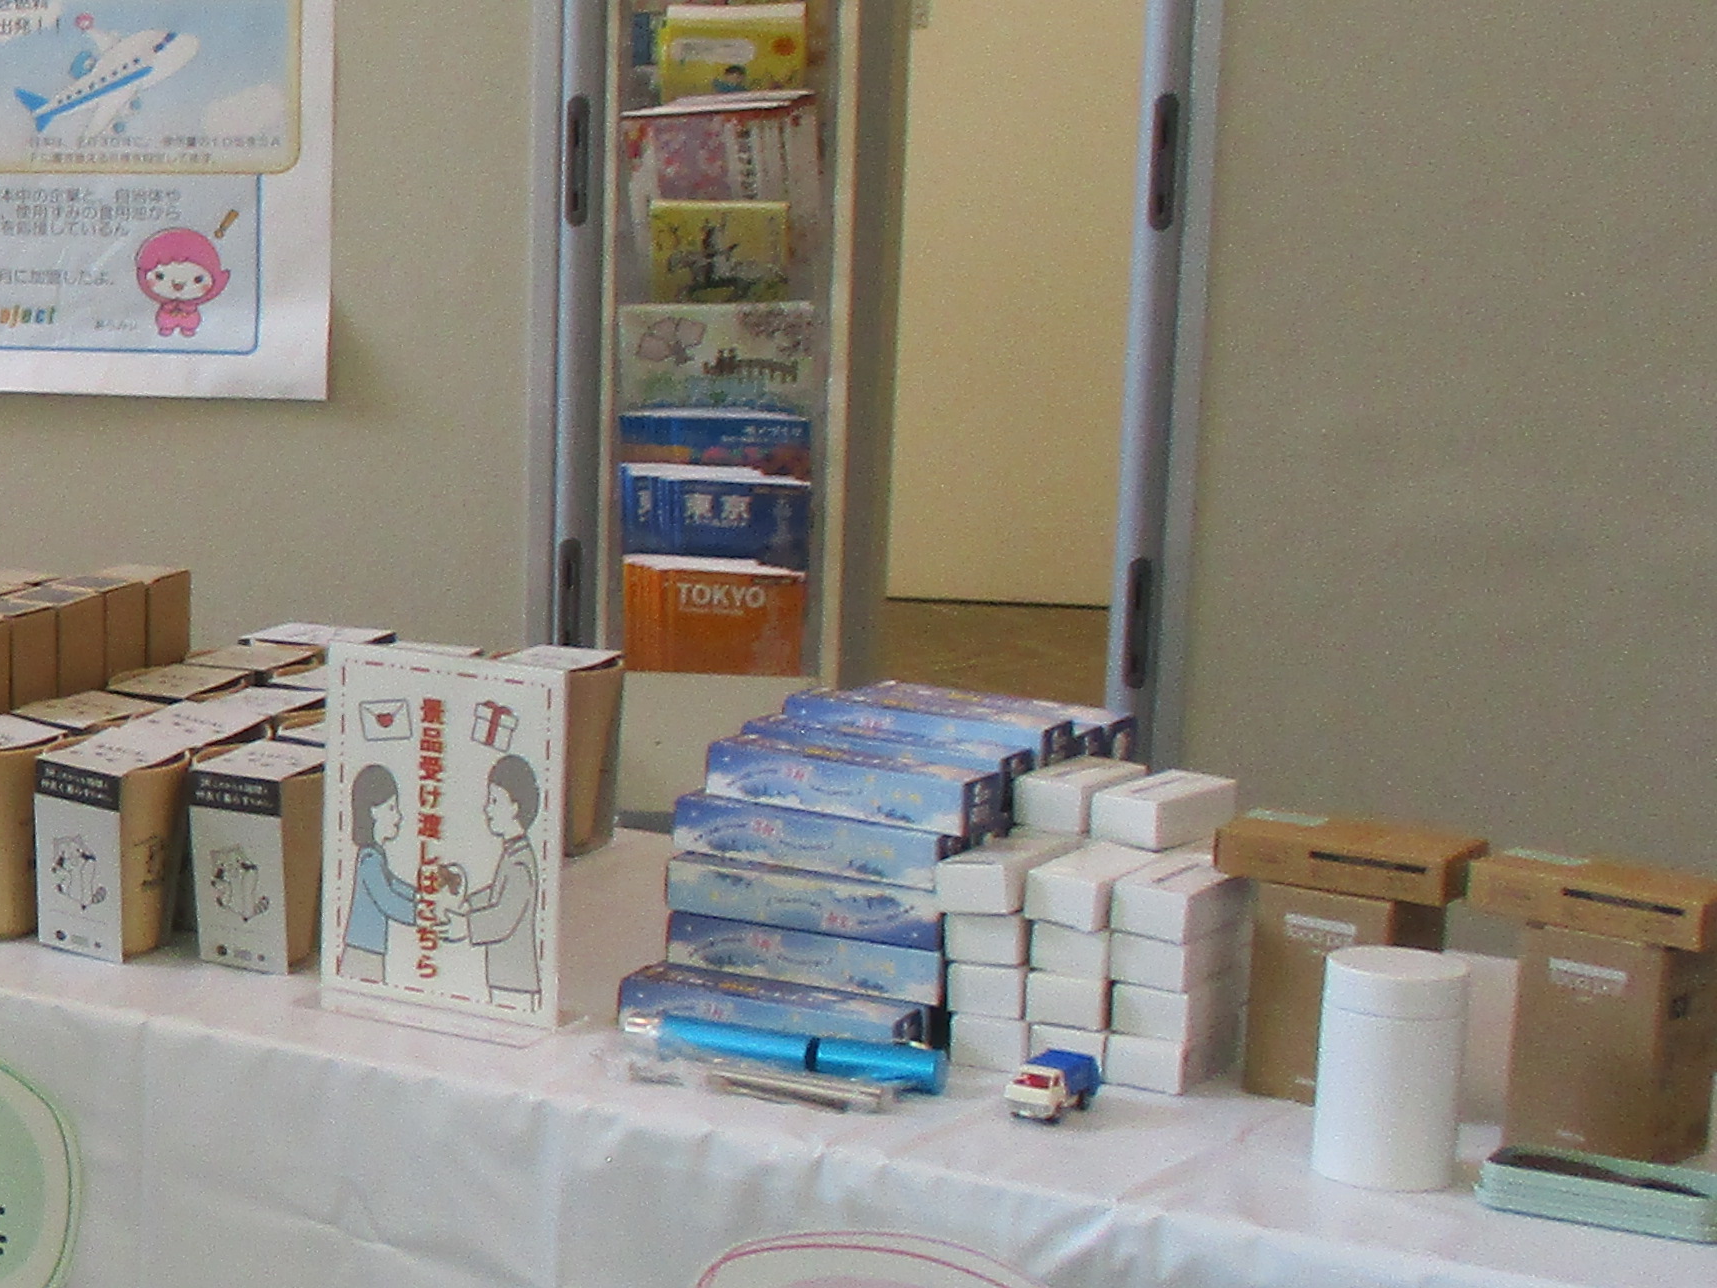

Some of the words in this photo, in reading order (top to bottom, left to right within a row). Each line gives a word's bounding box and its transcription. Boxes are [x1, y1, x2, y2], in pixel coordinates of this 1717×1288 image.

[676, 581, 767, 609] TOKYO
[415, 697, 446, 980] 景品受け渡しはこちら
